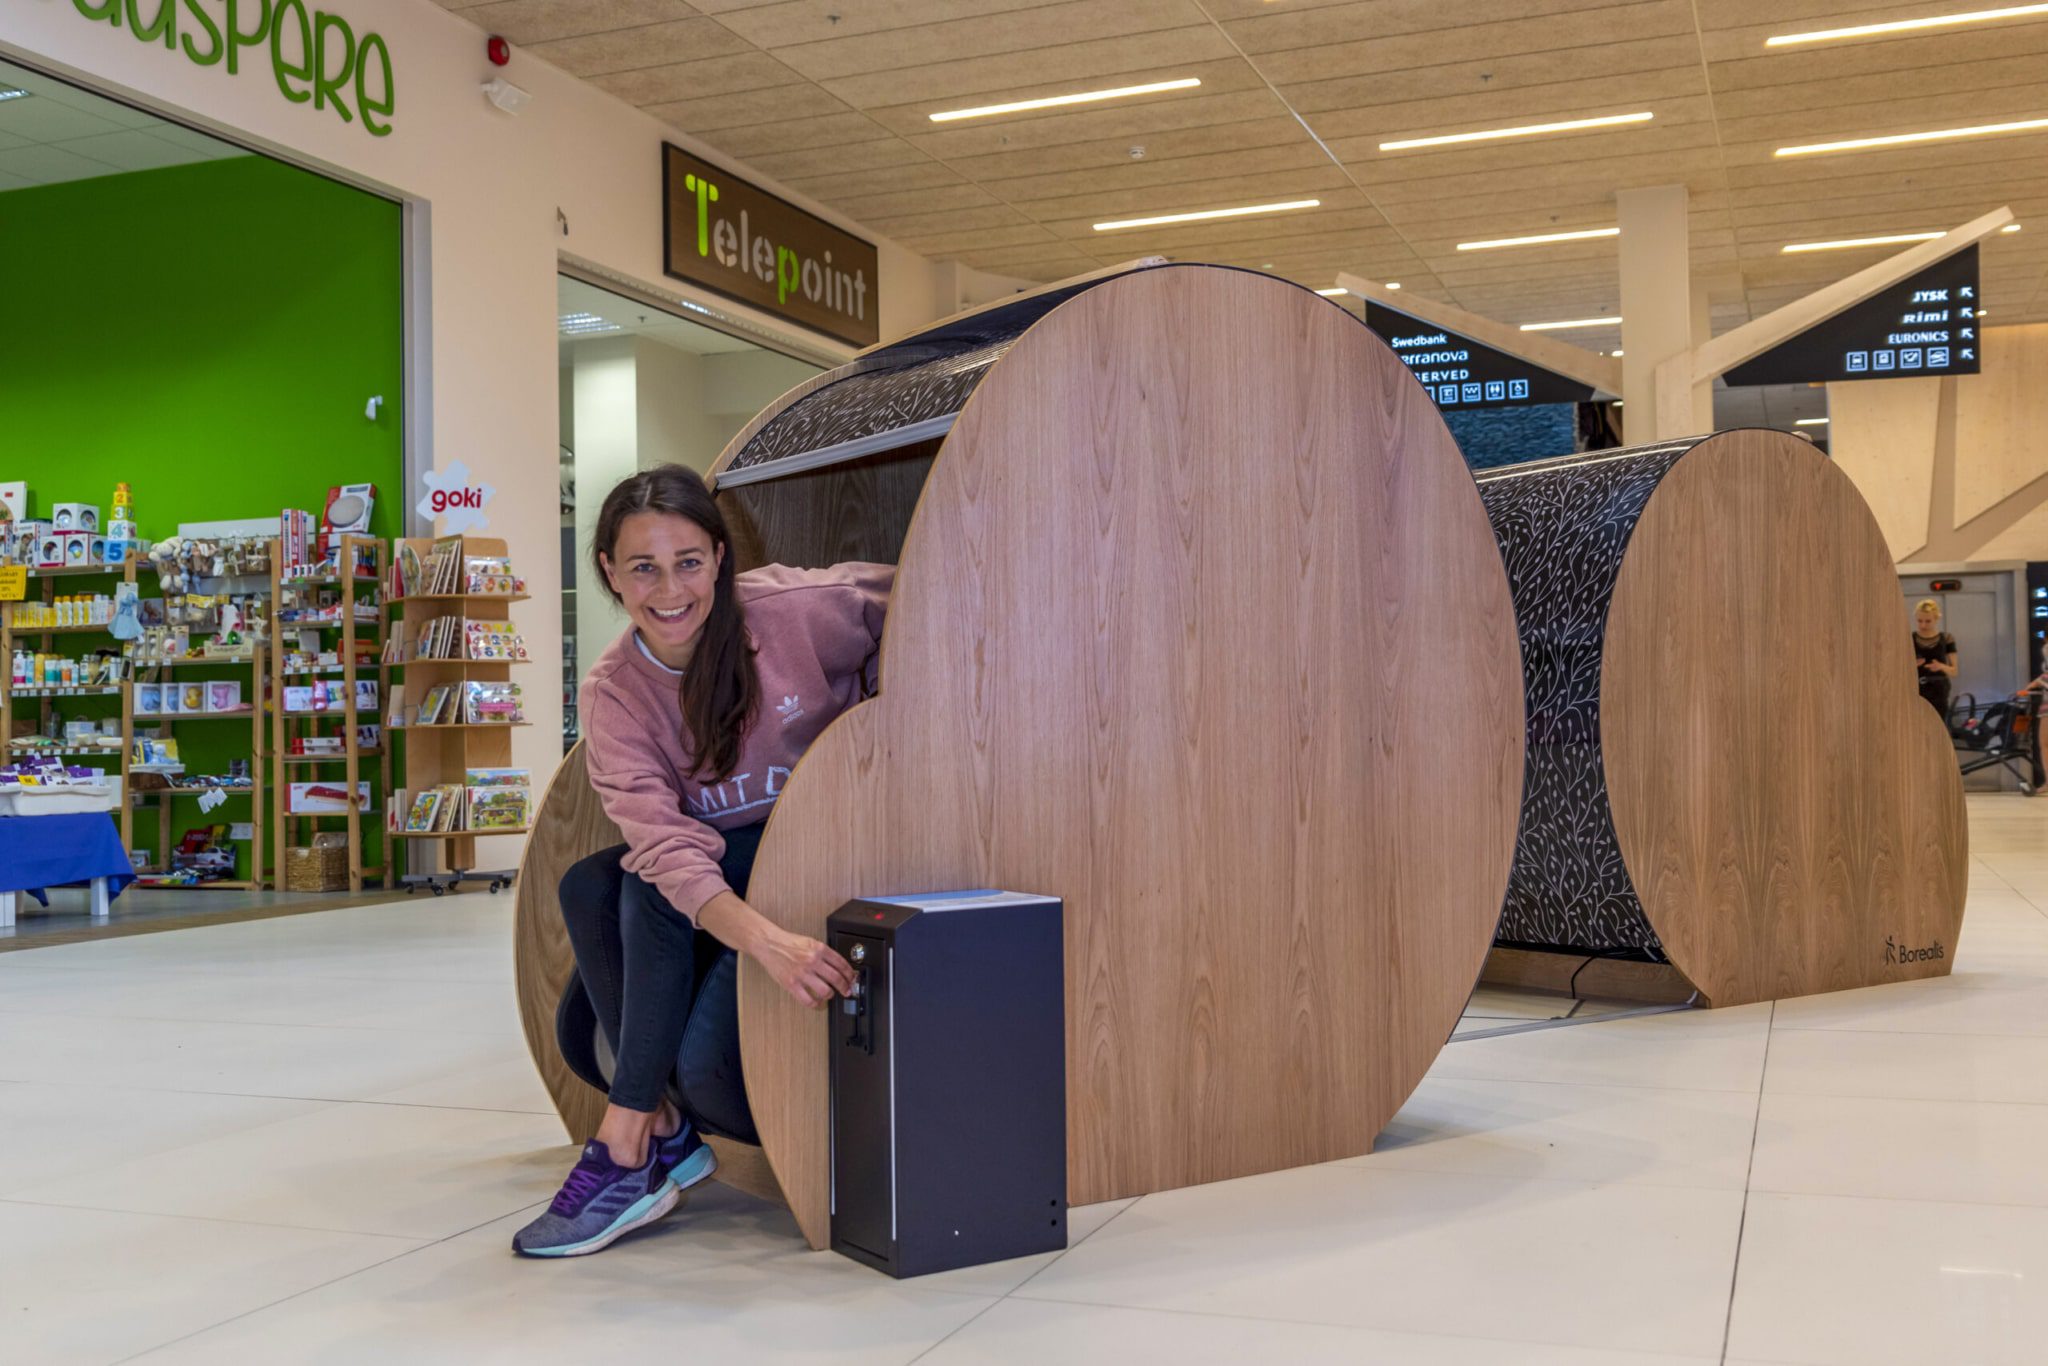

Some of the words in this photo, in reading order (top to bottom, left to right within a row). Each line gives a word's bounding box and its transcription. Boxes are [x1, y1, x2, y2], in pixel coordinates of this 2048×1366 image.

[685, 174, 866, 320] Telepoint
[1912, 290, 1948, 303] JYSK
[1392, 334, 1447, 348] Swedbank
[1887, 331, 1949, 344] EURONICS
[431, 487, 482, 512] goki
[114, 506, 124, 518] 3
[111, 523, 124, 537] 4
[108, 543, 122, 561] 5
[1899, 940, 1944, 964] Borealis
